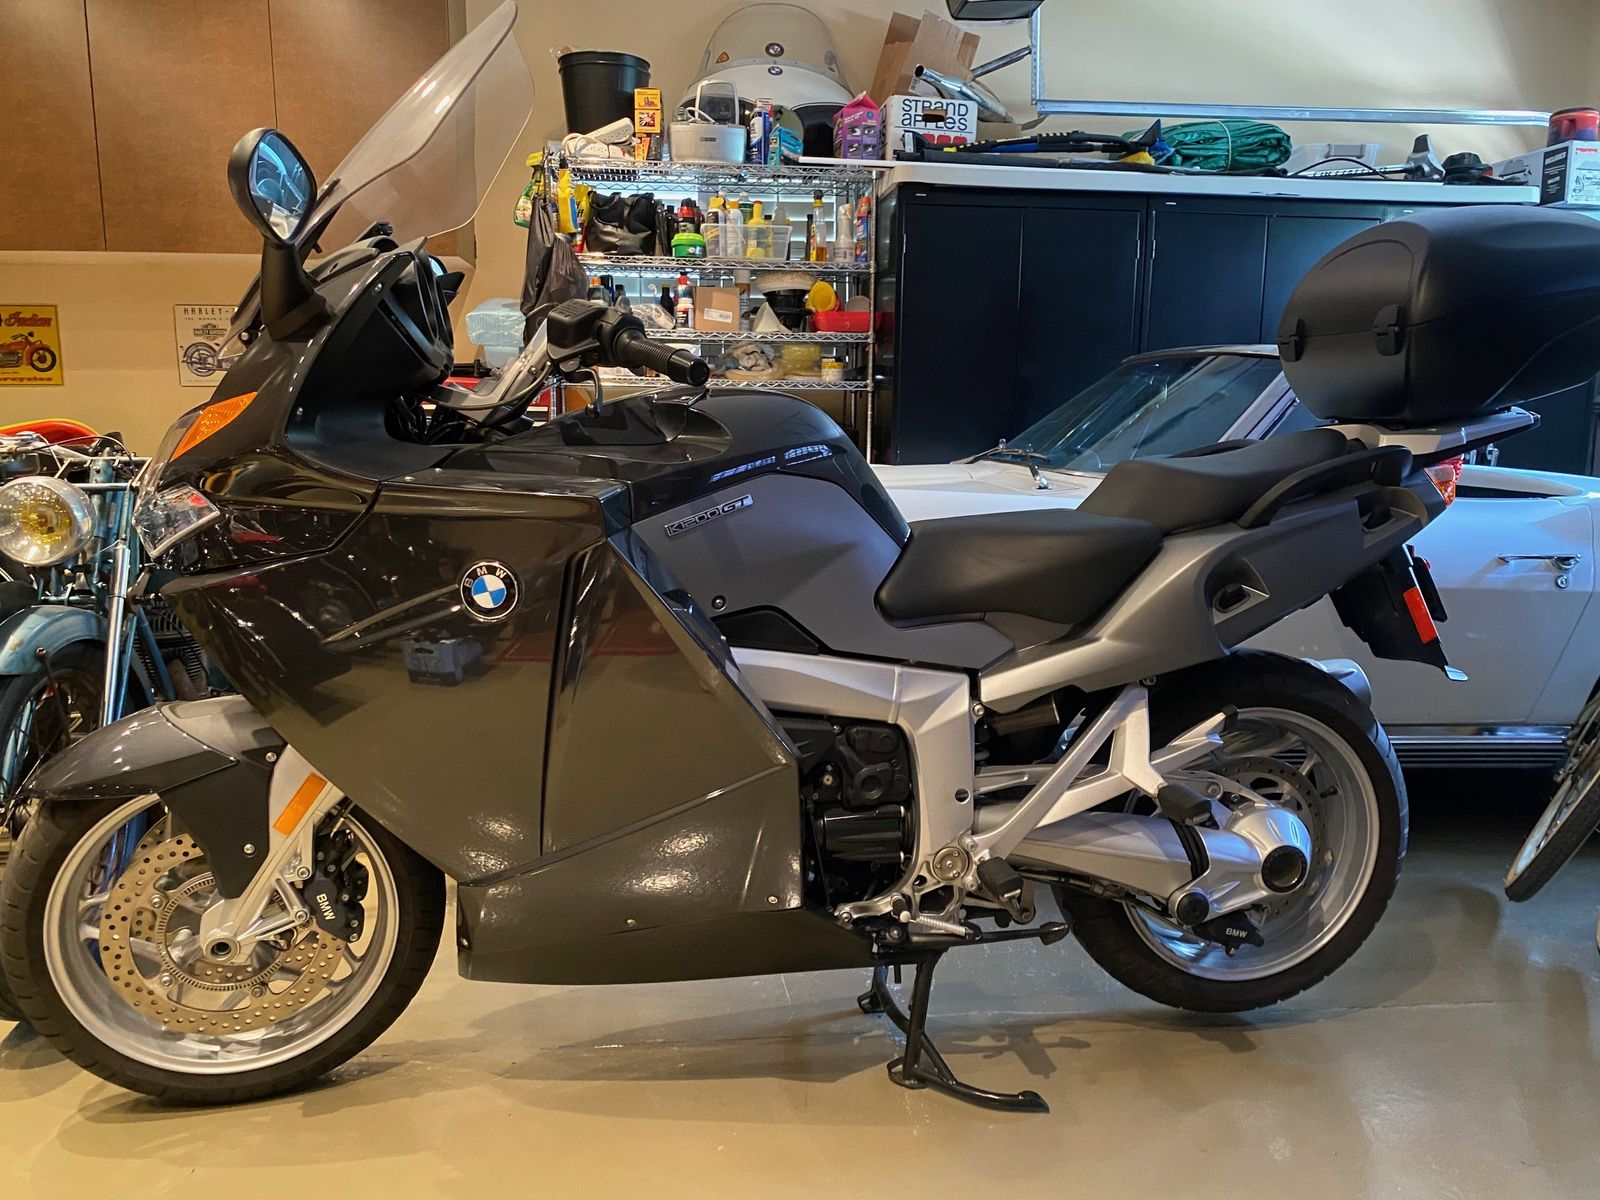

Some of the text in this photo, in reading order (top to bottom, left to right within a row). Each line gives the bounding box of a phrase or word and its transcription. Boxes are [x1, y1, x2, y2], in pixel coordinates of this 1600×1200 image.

[4, 311, 52, 328] Indian
[183, 307, 236, 315] HARLEY-
[464, 566, 507, 588] BMW
[316, 893, 336, 920] BMW
[1225, 927, 1248, 938] BMW
